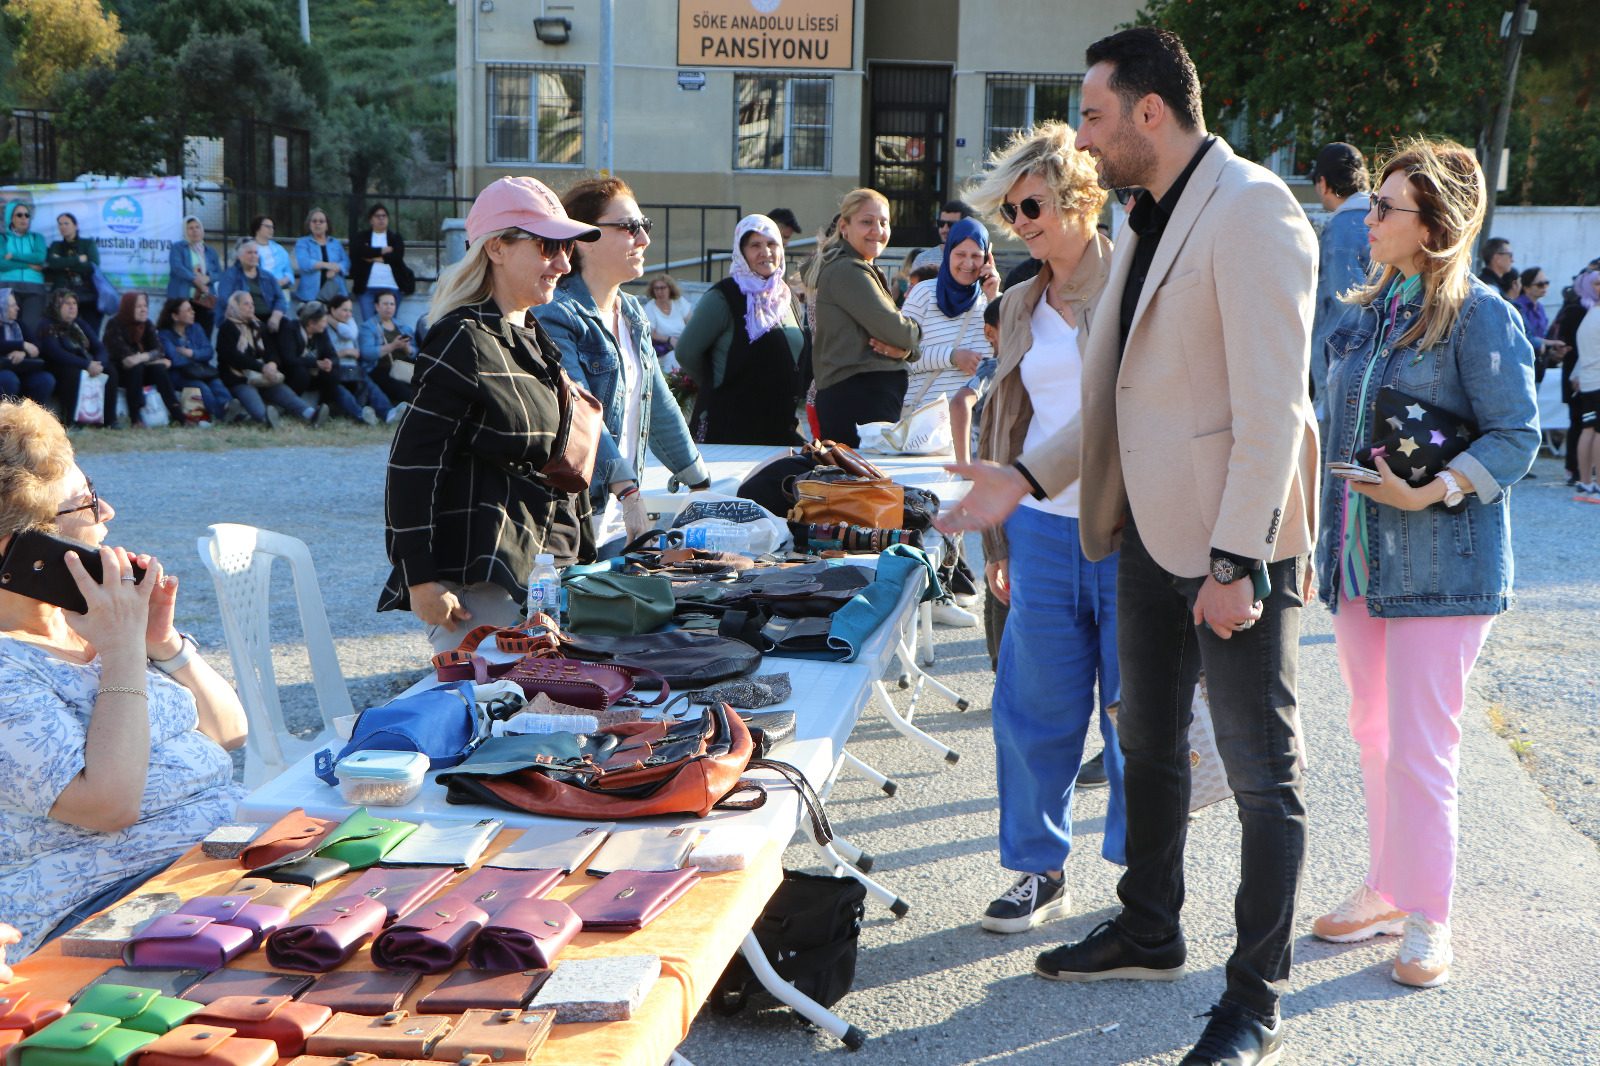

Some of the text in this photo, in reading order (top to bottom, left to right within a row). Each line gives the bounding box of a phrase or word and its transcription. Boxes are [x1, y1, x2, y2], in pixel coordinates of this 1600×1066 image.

[693, 11, 839, 32] SÖKE ANADOLU LİSESİ
[701, 32, 829, 60] PANSİYONU
